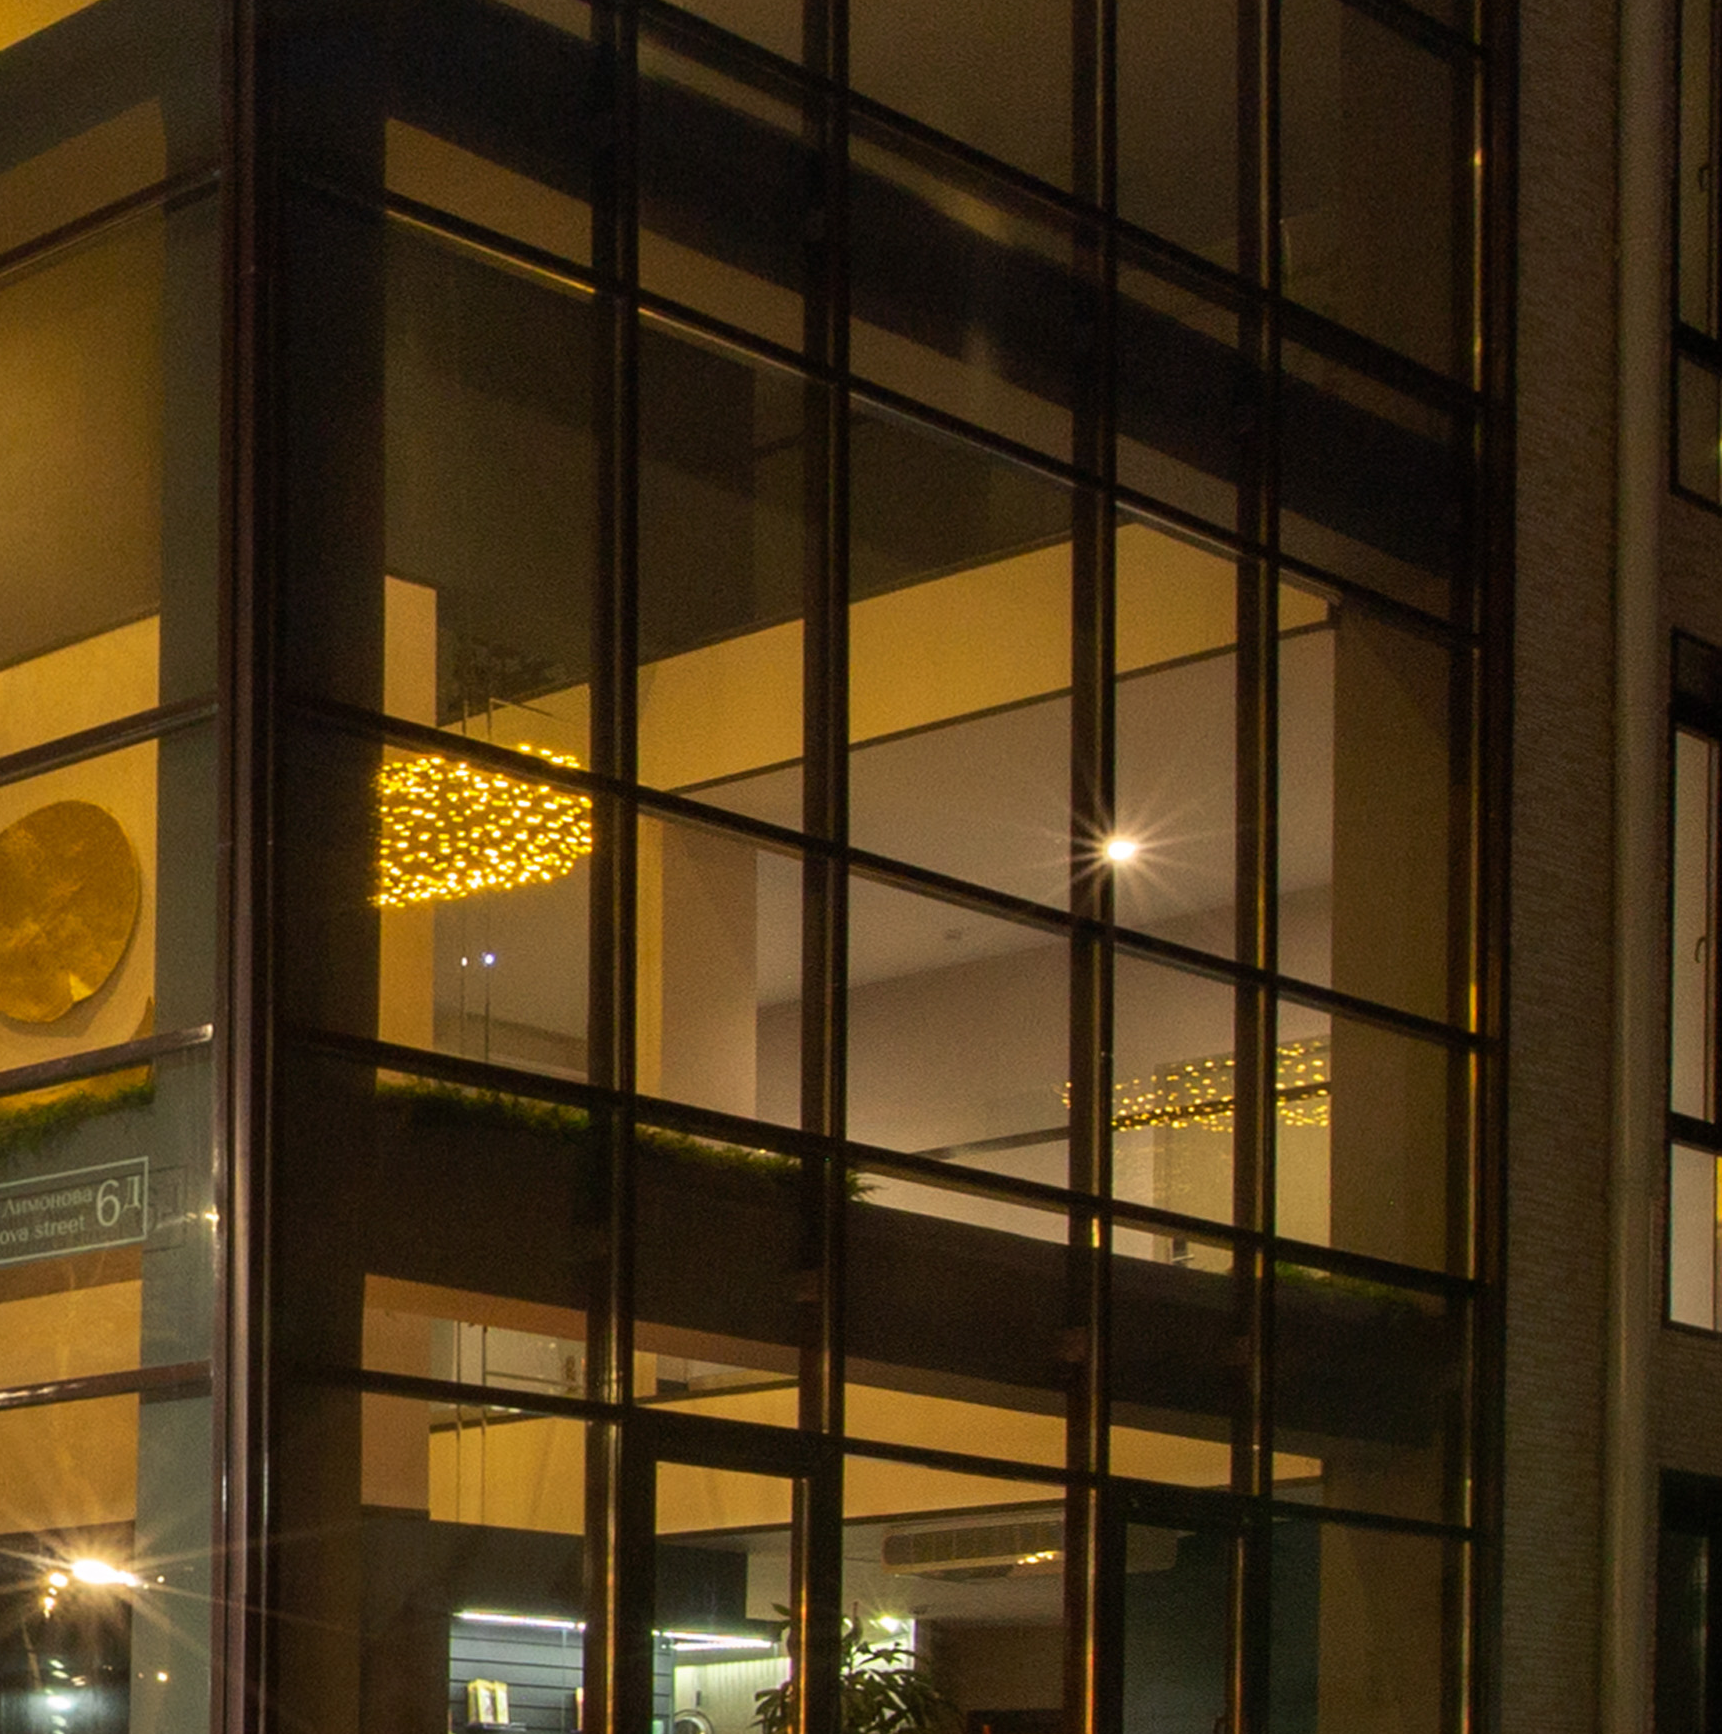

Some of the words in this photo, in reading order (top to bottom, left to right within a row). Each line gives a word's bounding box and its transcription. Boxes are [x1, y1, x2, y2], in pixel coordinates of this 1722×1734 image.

[2, 1186, 93, 1218] Лимонова
[96, 1175, 141, 1227] 6Д
[34, 1214, 85, 1239] street
